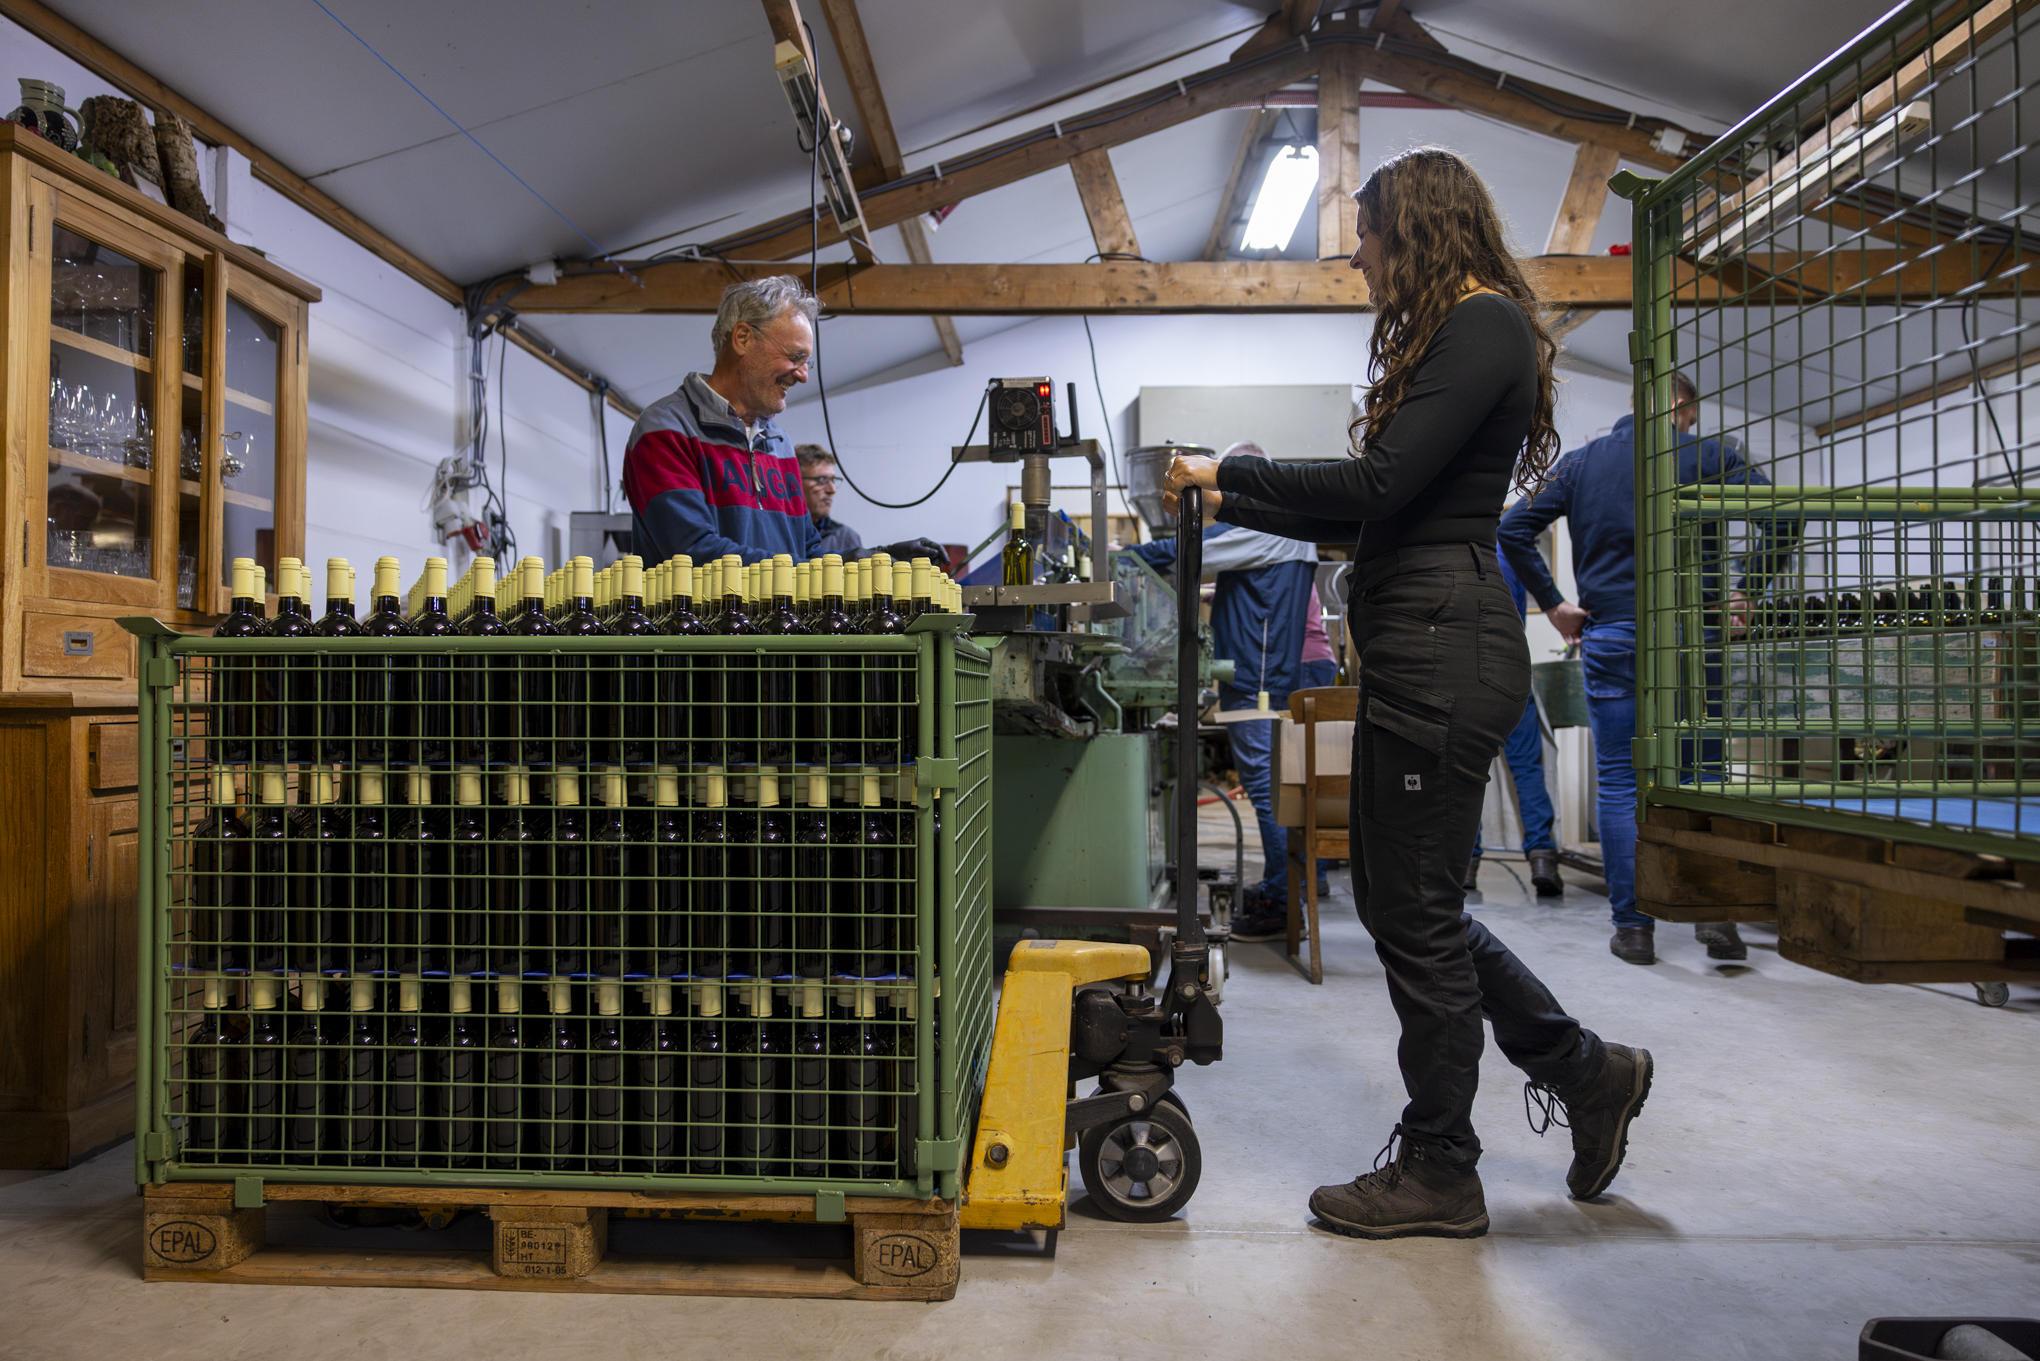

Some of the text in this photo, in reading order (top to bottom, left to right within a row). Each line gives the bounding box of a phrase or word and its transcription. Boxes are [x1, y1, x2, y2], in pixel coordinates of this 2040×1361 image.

[161, 1230, 208, 1254] EPAL
[521, 1253, 533, 1261] HT
[879, 1244, 928, 1269] EPAL
